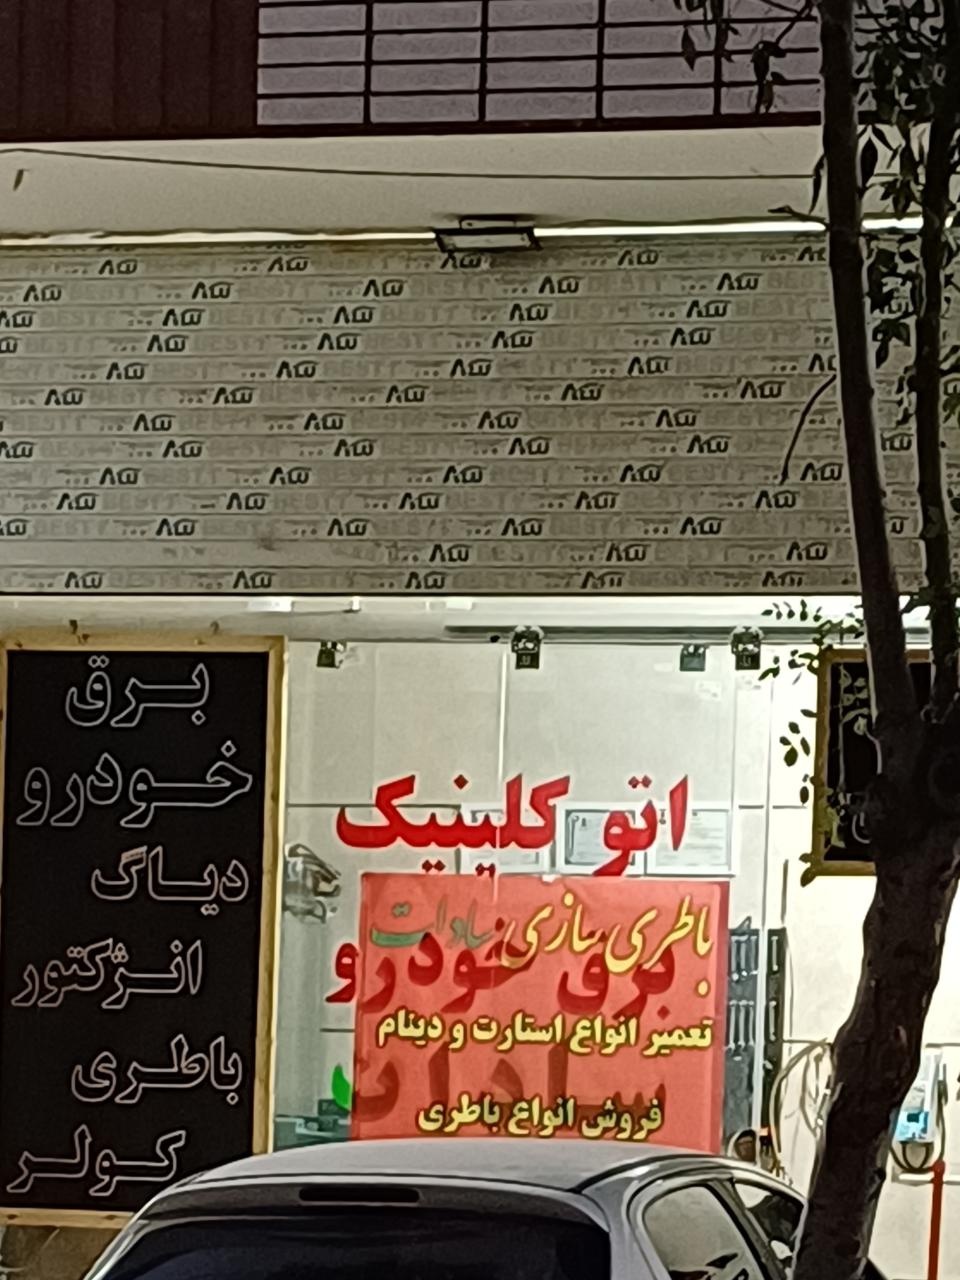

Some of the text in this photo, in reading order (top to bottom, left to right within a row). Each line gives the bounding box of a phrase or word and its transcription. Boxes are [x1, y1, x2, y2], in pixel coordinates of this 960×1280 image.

[65, 655, 210, 727] برق
[15, 740, 253, 828] خودرو
[335, 773, 571, 879] کلینیک
[592, 774, 688, 877] اتو
[91, 845, 249, 916] دیاگ
[499, 893, 606, 969] سازی
[604, 895, 714, 998] باطری
[11, 939, 203, 1009] انژکتور
[377, 1008, 713, 1056] تعمیر انواع استارت و دینام
[71, 1034, 242, 1105] باطری
[416, 1091, 664, 1140] فروش انواع باطری
[6, 1124, 186, 1197] کولر
